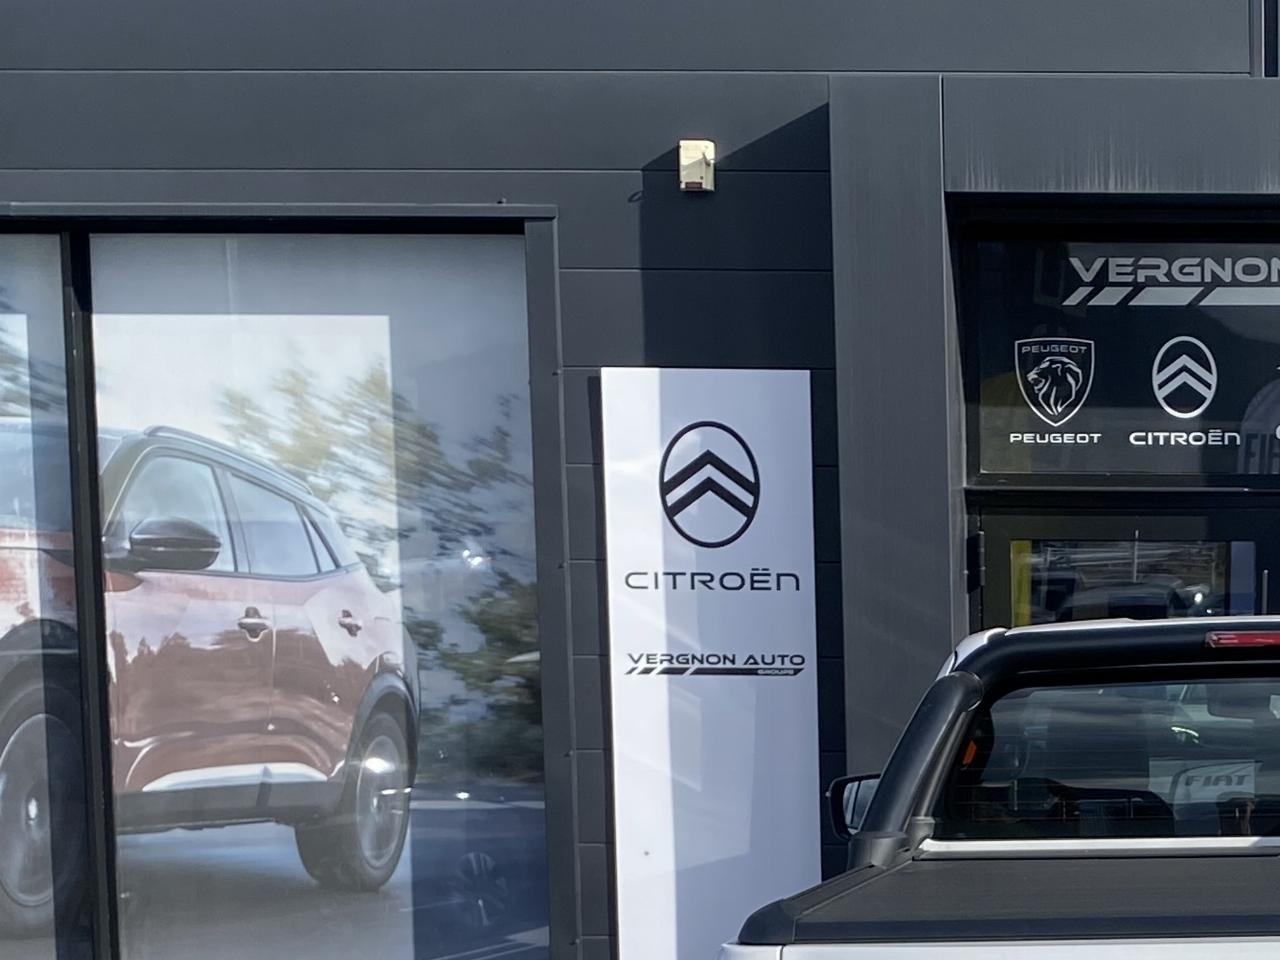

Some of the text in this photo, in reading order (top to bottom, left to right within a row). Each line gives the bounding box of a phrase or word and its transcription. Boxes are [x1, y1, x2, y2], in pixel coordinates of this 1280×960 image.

[1022, 345, 1088, 354] PEUGEOT
[1009, 433, 1102, 443] PEUGEOT
[1129, 429, 1241, 446] CITROËN
[624, 568, 801, 591] CITROËN
[627, 653, 806, 666] VERGNON AUTO
[1184, 774, 1252, 787] FIAT
